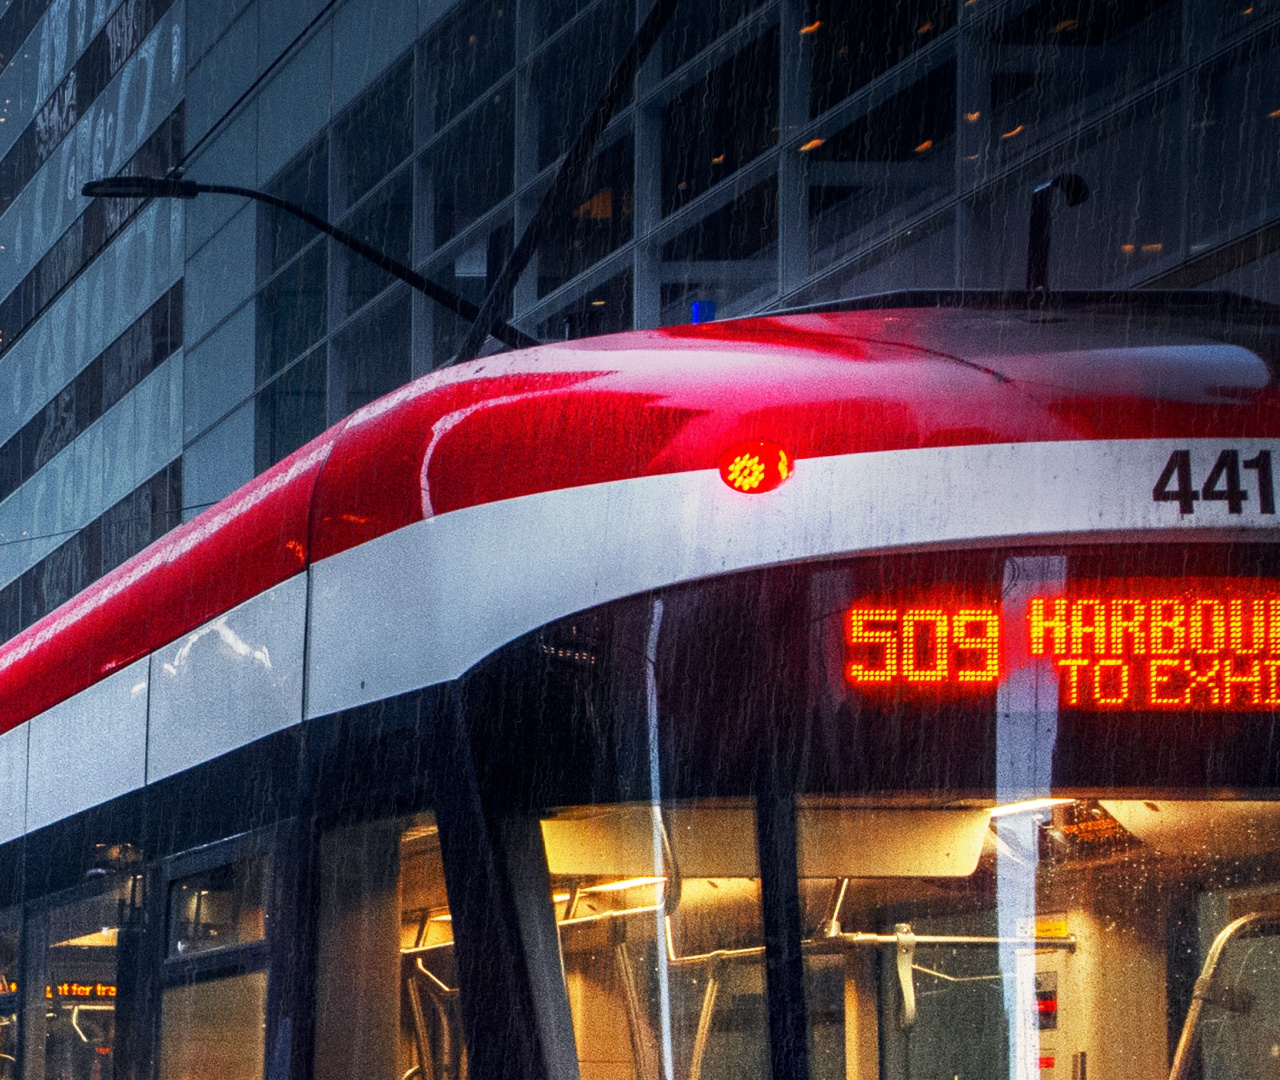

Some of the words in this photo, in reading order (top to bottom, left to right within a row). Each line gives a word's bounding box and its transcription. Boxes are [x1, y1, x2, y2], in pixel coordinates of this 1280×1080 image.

[850, 608, 1000, 682] 509
[1028, 598, 1280, 655] HARBOU
[1059, 658, 1130, 705] TO
